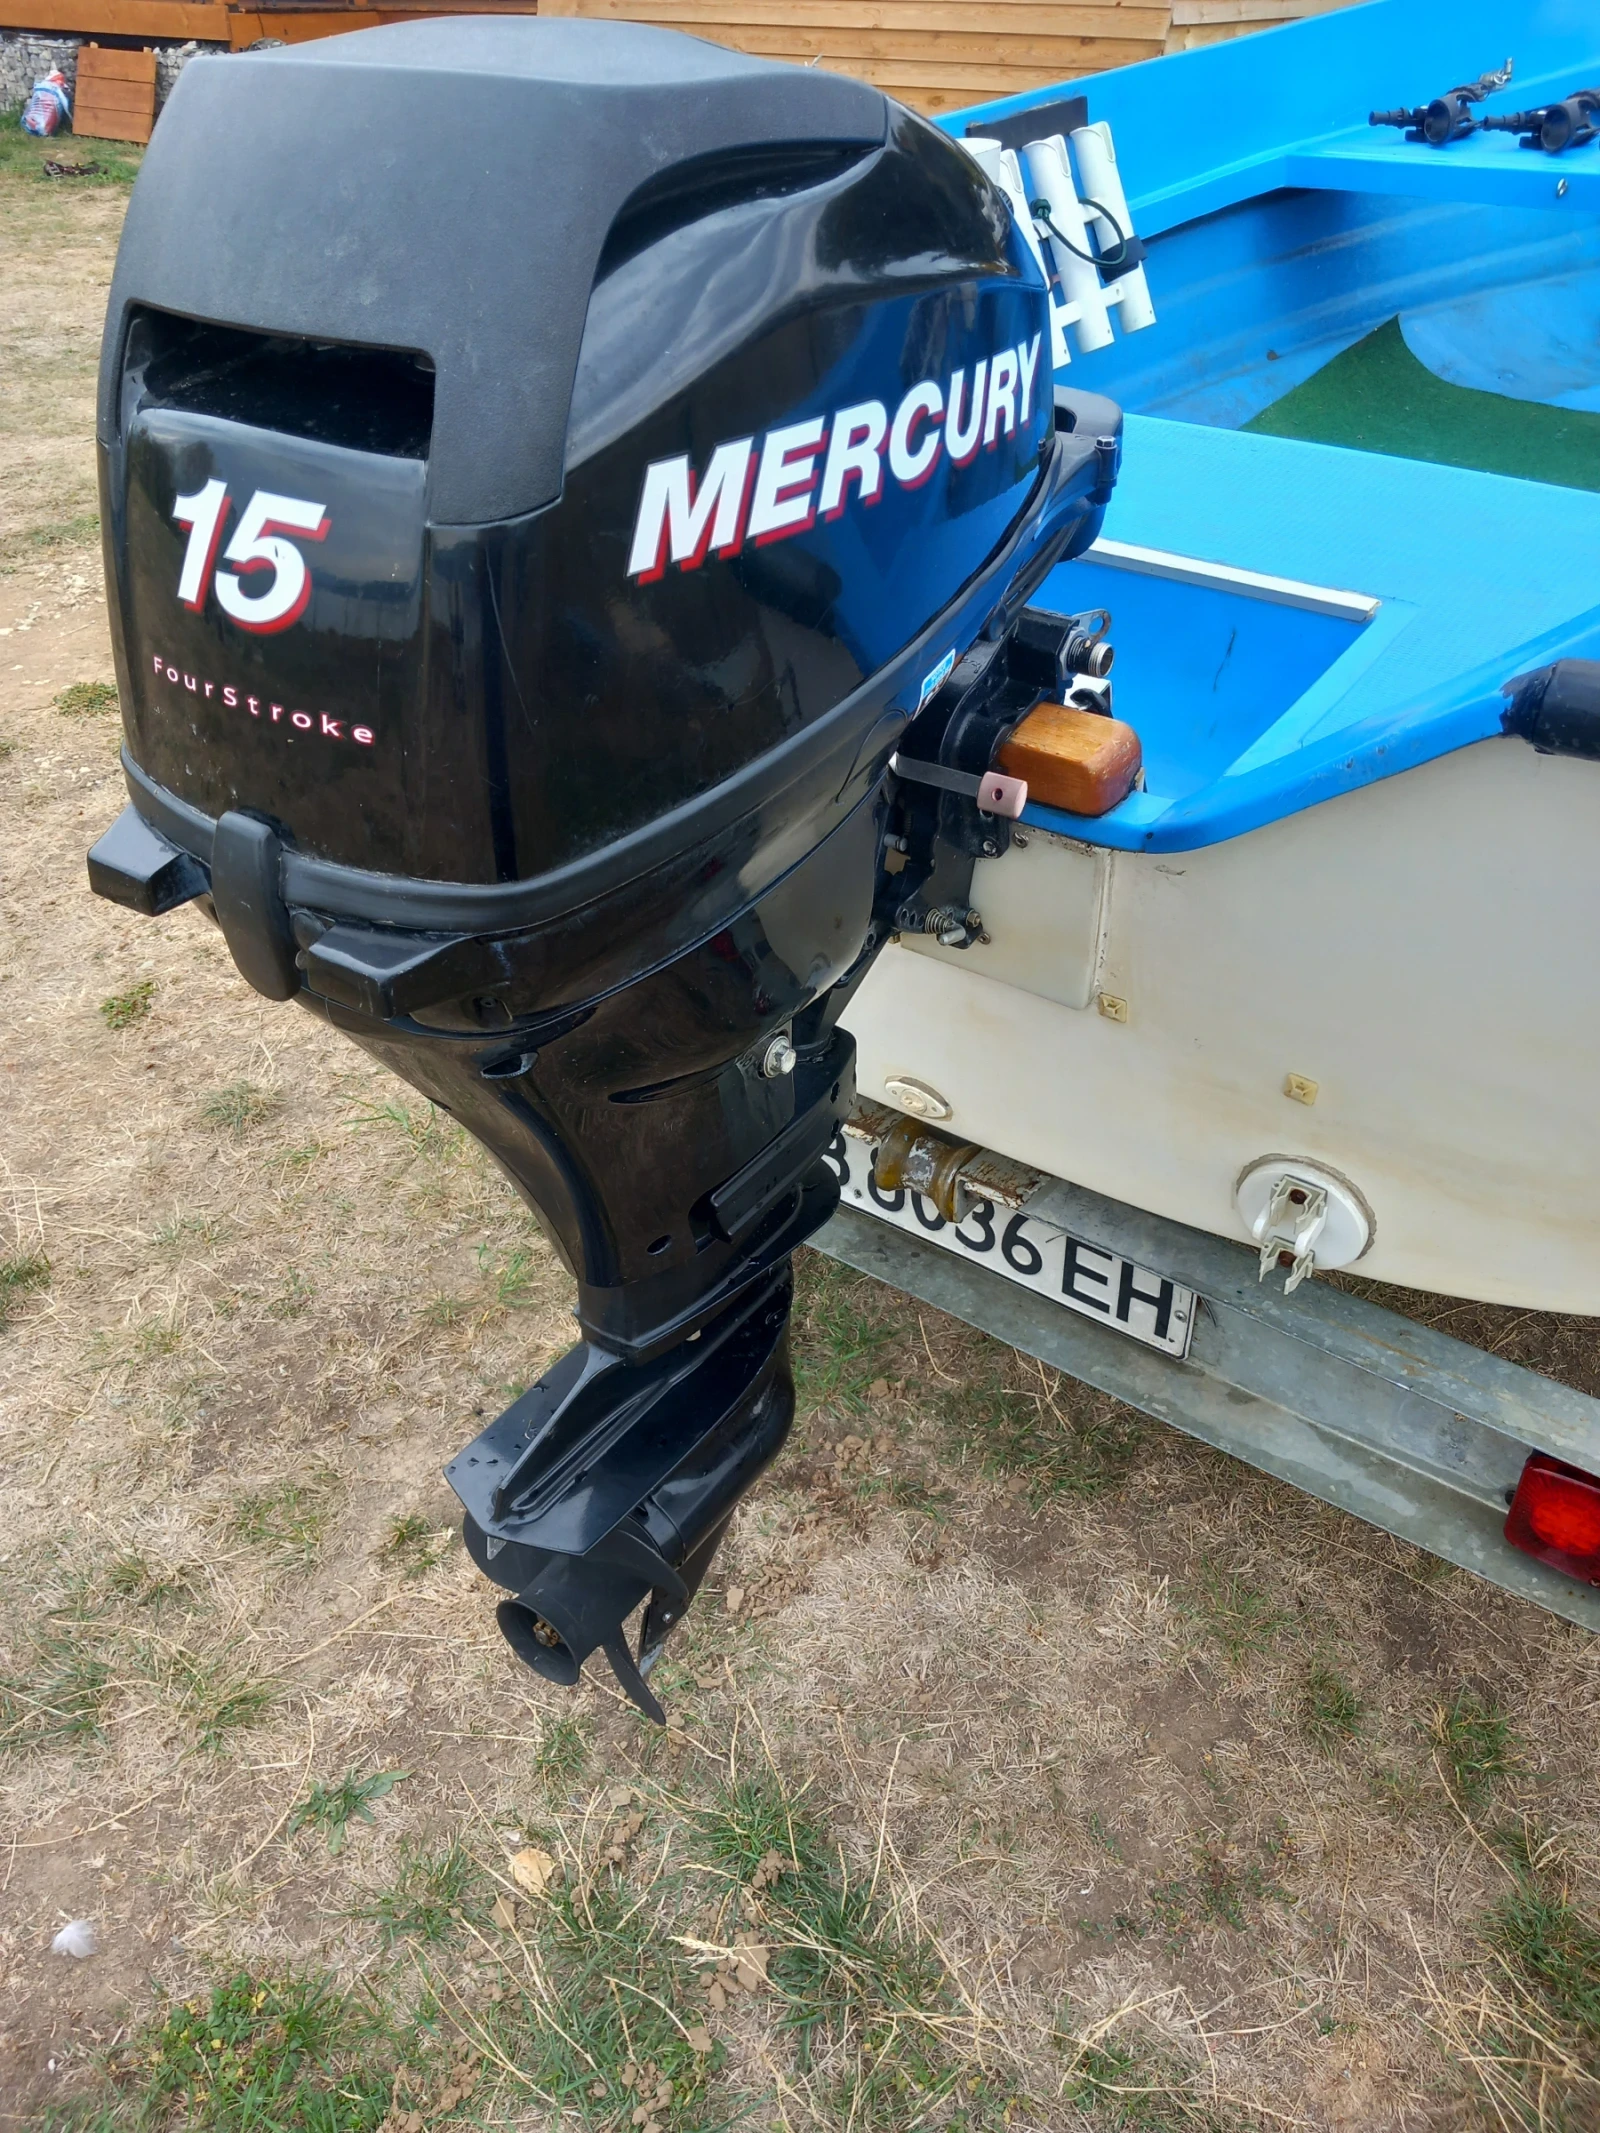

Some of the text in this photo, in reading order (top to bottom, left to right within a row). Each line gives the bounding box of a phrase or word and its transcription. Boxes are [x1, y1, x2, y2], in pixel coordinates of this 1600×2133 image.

[625, 331, 1042, 585] MERCURY
[172, 478, 332, 635] 15
[153, 655, 376, 746] FourStroke
[1061, 1236, 1174, 1339] EH
